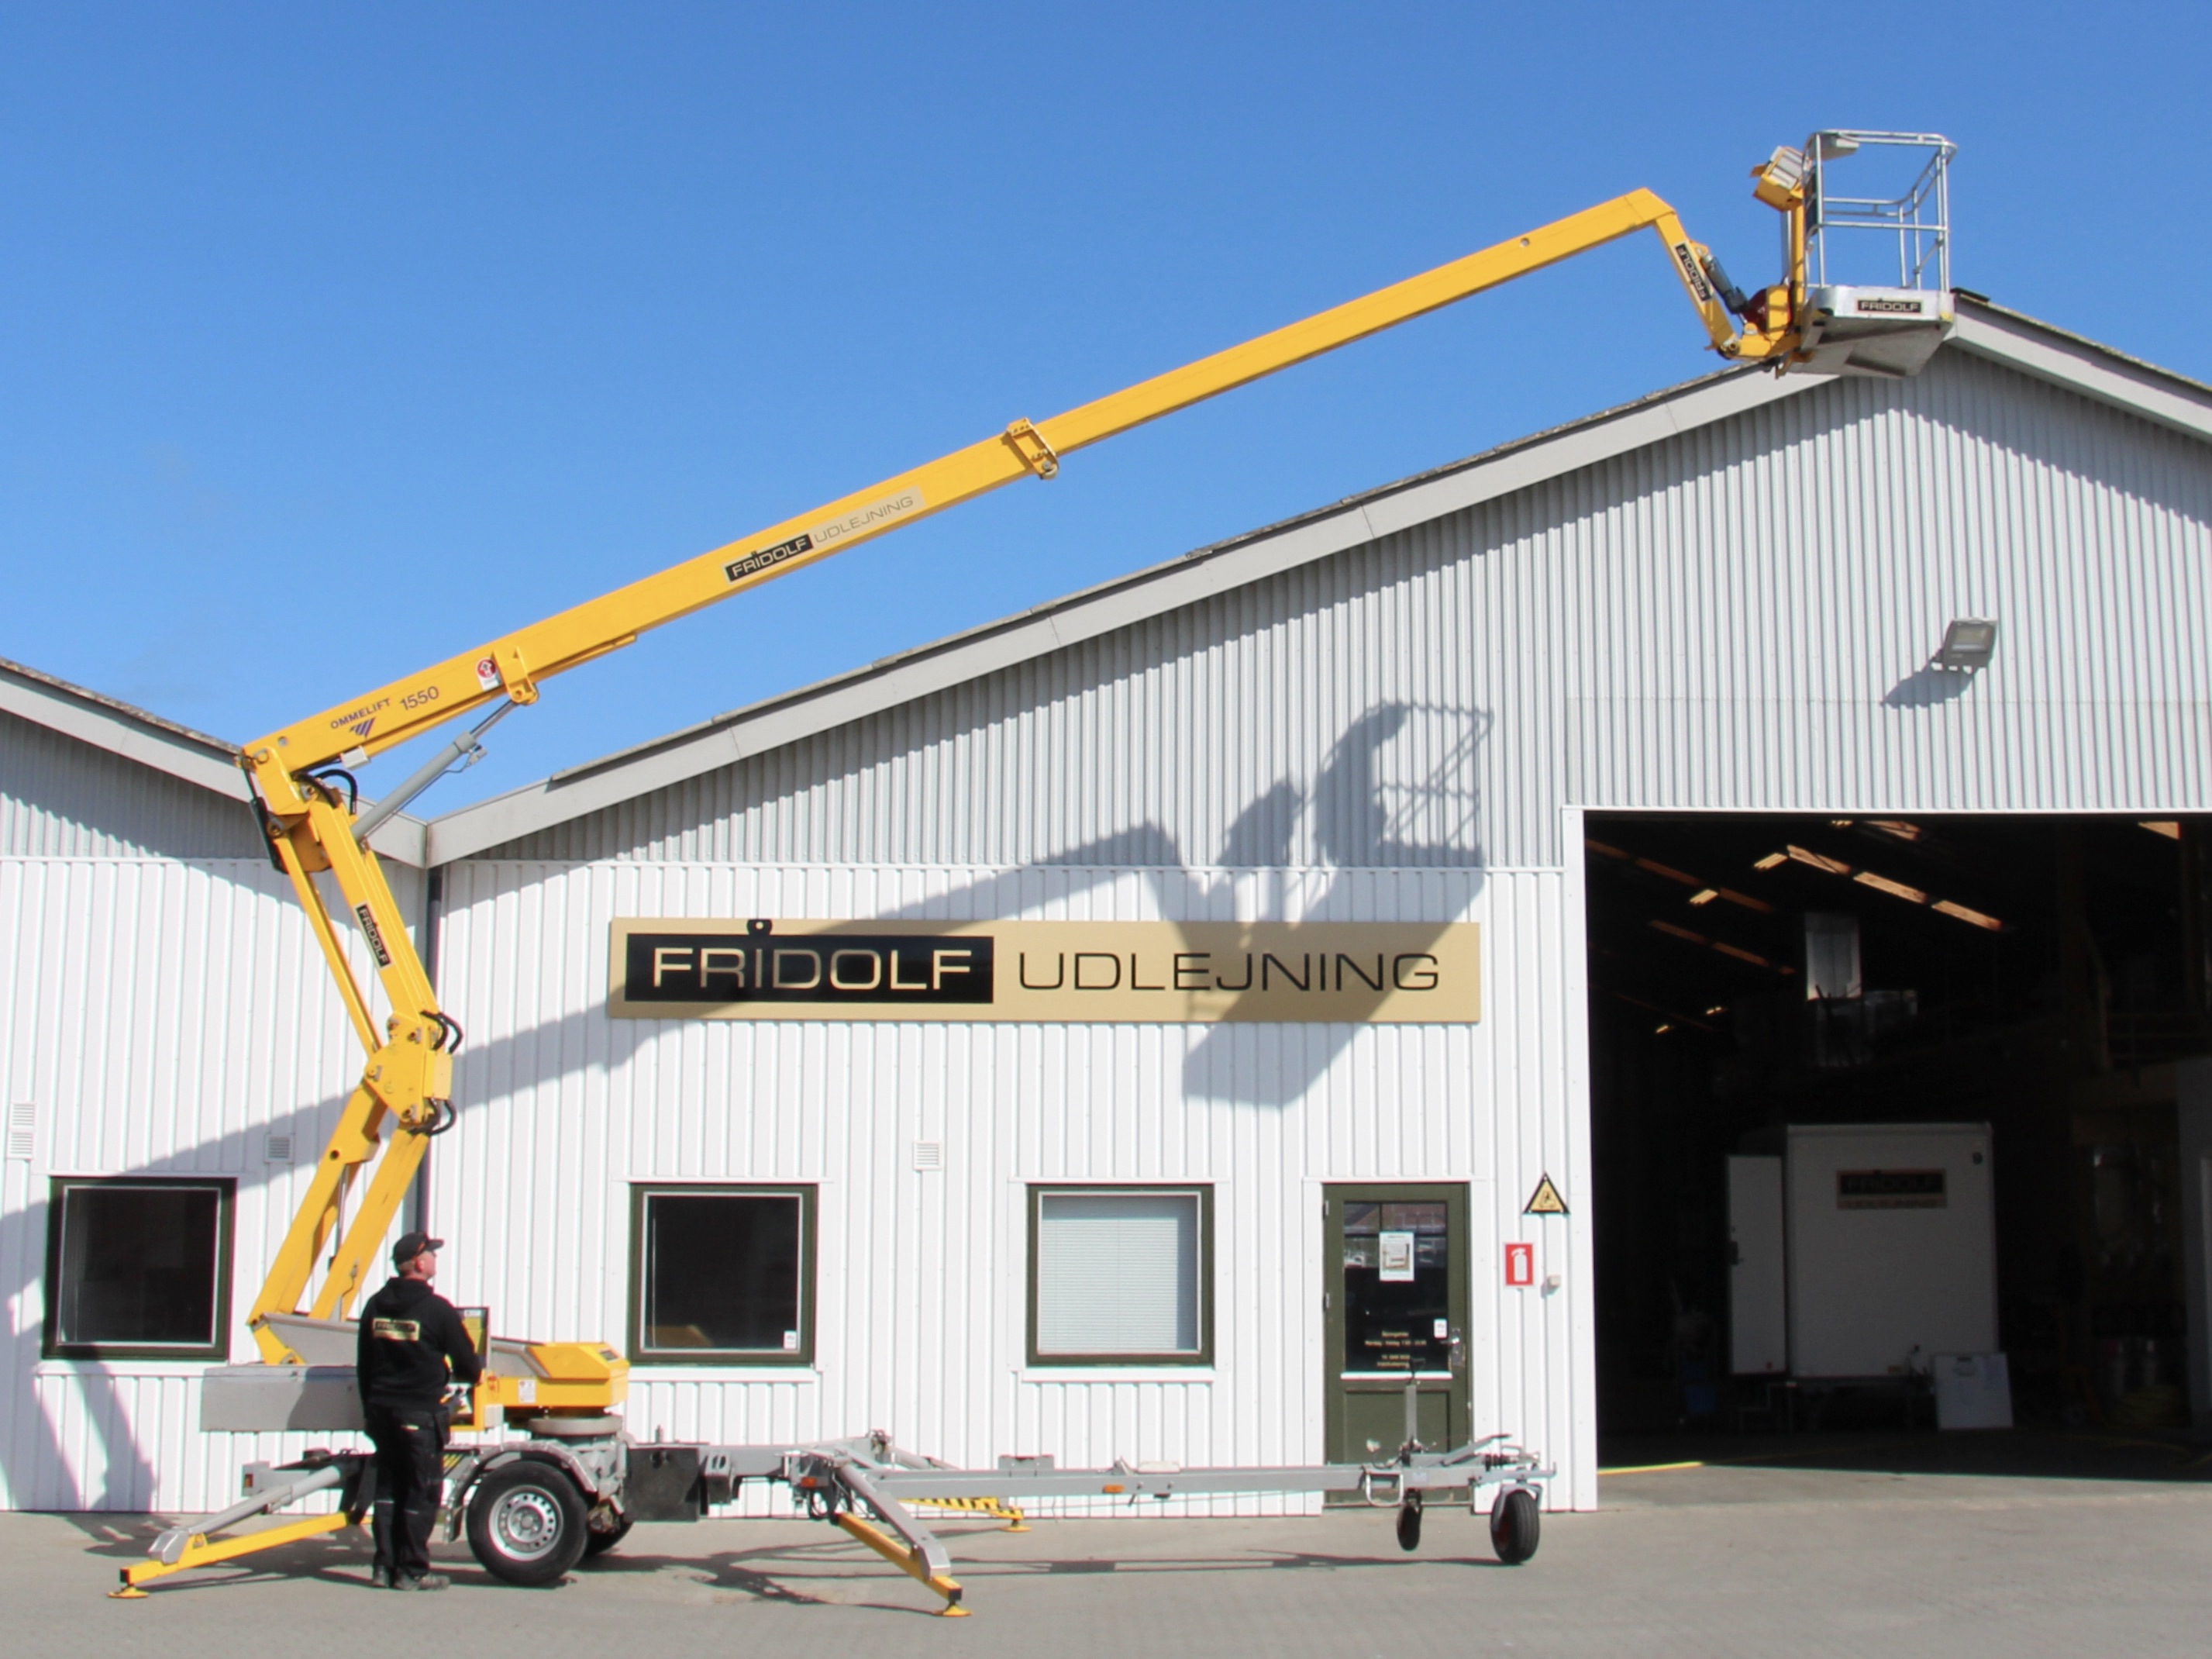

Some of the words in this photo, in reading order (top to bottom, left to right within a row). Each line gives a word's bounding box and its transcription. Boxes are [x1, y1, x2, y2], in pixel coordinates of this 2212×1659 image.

[1677, 247, 1707, 298] FRIDOLF
[1861, 301, 1919, 312] FRIDOLF
[731, 537, 808, 578] FRIDOLF
[814, 495, 914, 543] UDLEJNING
[330, 697, 391, 729] OMMELIFT
[400, 685, 439, 711] 1550
[359, 909, 388, 963] FRIDOLF
[653, 947, 973, 990] FRIDOLF
[1018, 952, 1440, 992] UDLEJNING
